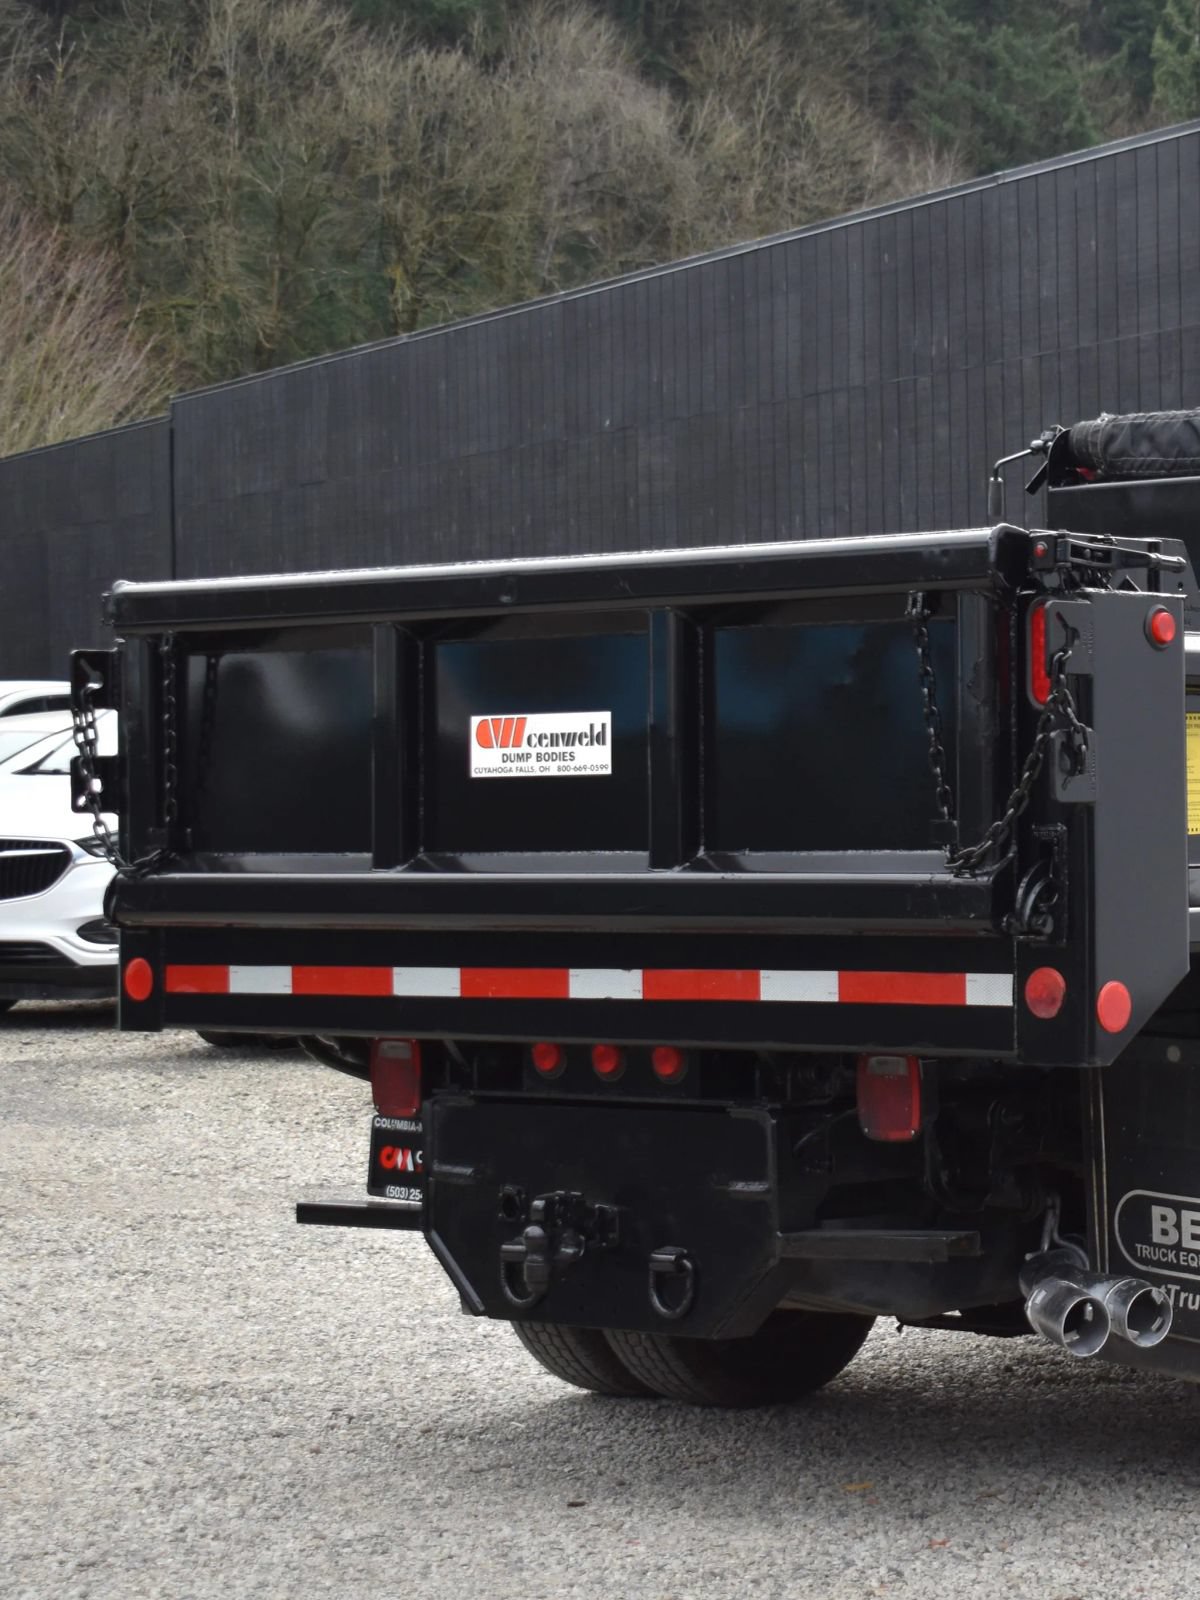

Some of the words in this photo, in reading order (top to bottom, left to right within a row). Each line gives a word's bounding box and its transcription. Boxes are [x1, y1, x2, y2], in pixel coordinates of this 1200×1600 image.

[502, 753, 532, 763] DUMP
[536, 751, 575, 763] BODIES
[557, 764, 609, 772] 800-669-0599
[386, 1185, 408, 1200] (503)
[1135, 1243, 1177, 1264] TRUCK
